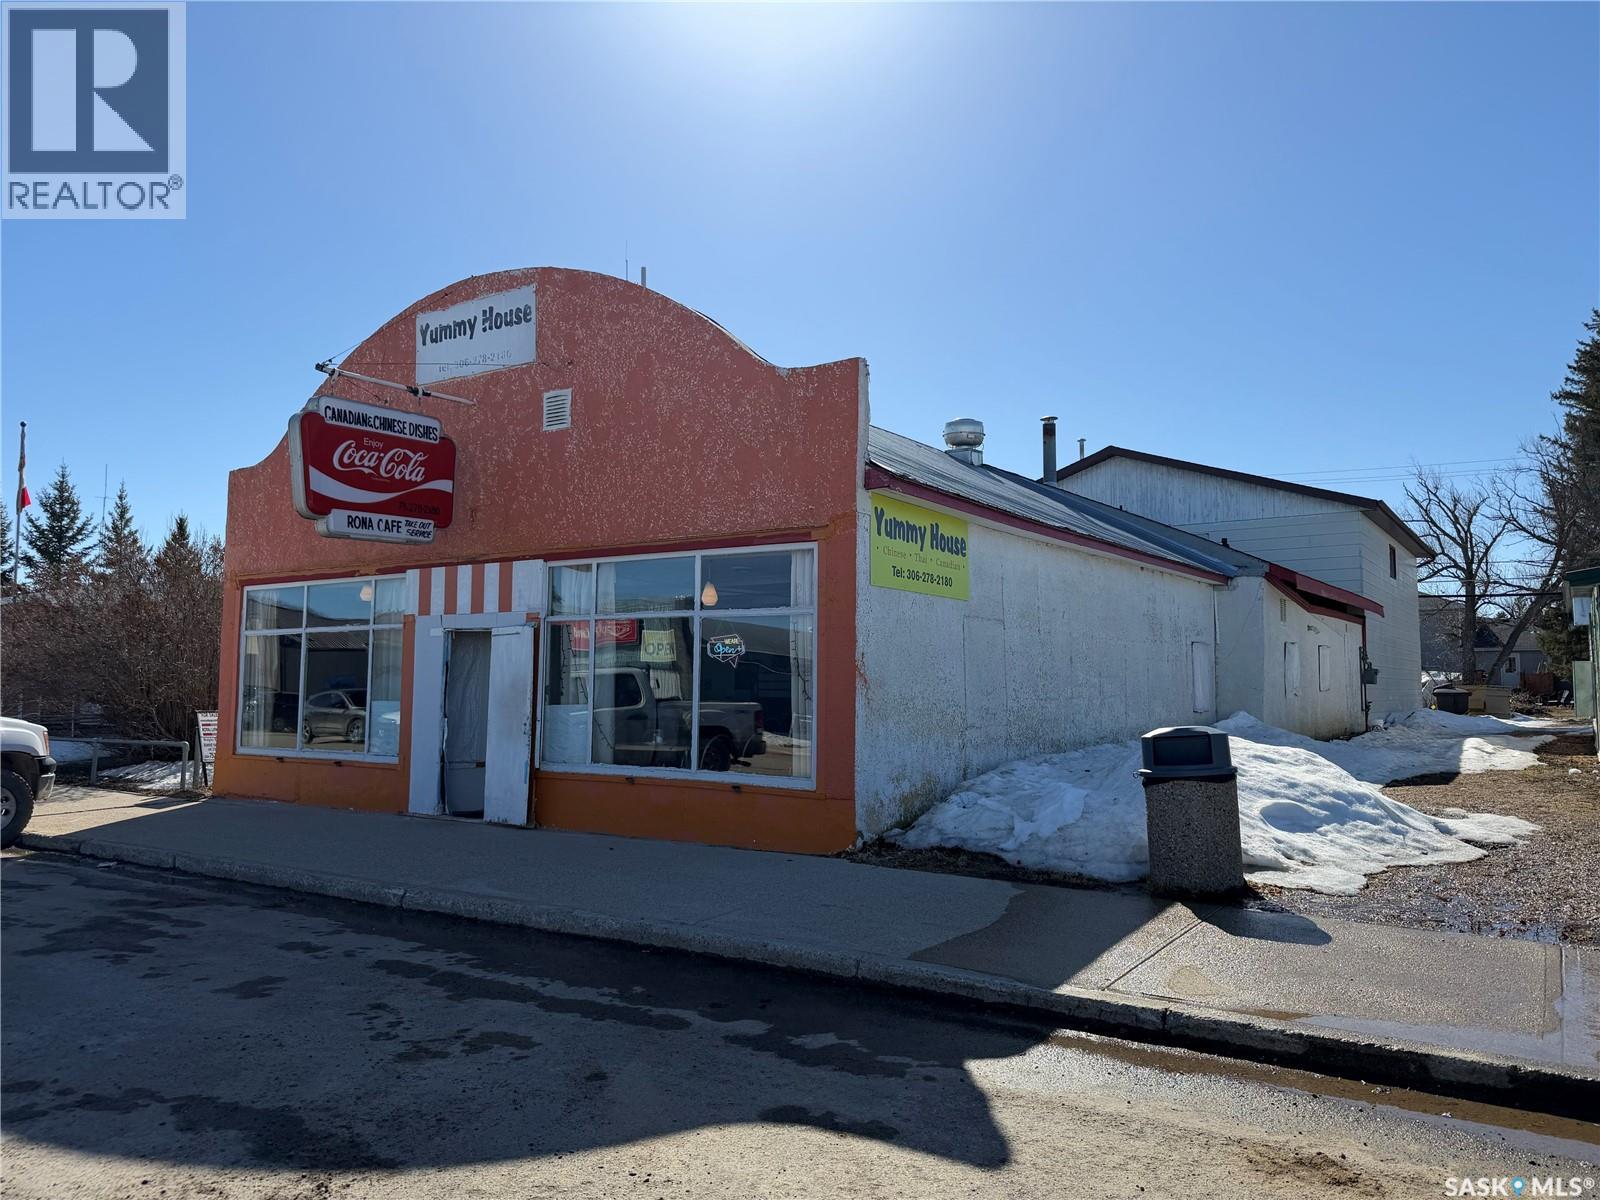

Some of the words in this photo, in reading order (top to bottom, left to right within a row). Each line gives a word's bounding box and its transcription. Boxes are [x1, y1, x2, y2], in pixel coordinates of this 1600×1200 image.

[419, 315, 477, 346] Yummy
[481, 303, 533, 333] House
[409, 423, 438, 442] DISHES
[363, 437, 384, 449] Enjoy
[332, 440, 428, 482] Coca-Cola
[347, 515, 374, 530] RONA
[377, 517, 402, 534] CAFE
[404, 519, 418, 529] TAKE
[418, 521, 432, 530] OUT
[406, 528, 432, 539] SERVICE
[874, 505, 927, 552] Yummy
[930, 522, 967, 558] House
[882, 545, 907, 559] Chinese
[892, 565, 905, 578] Tel:
[906, 570, 953, 588] 306-278-2180
